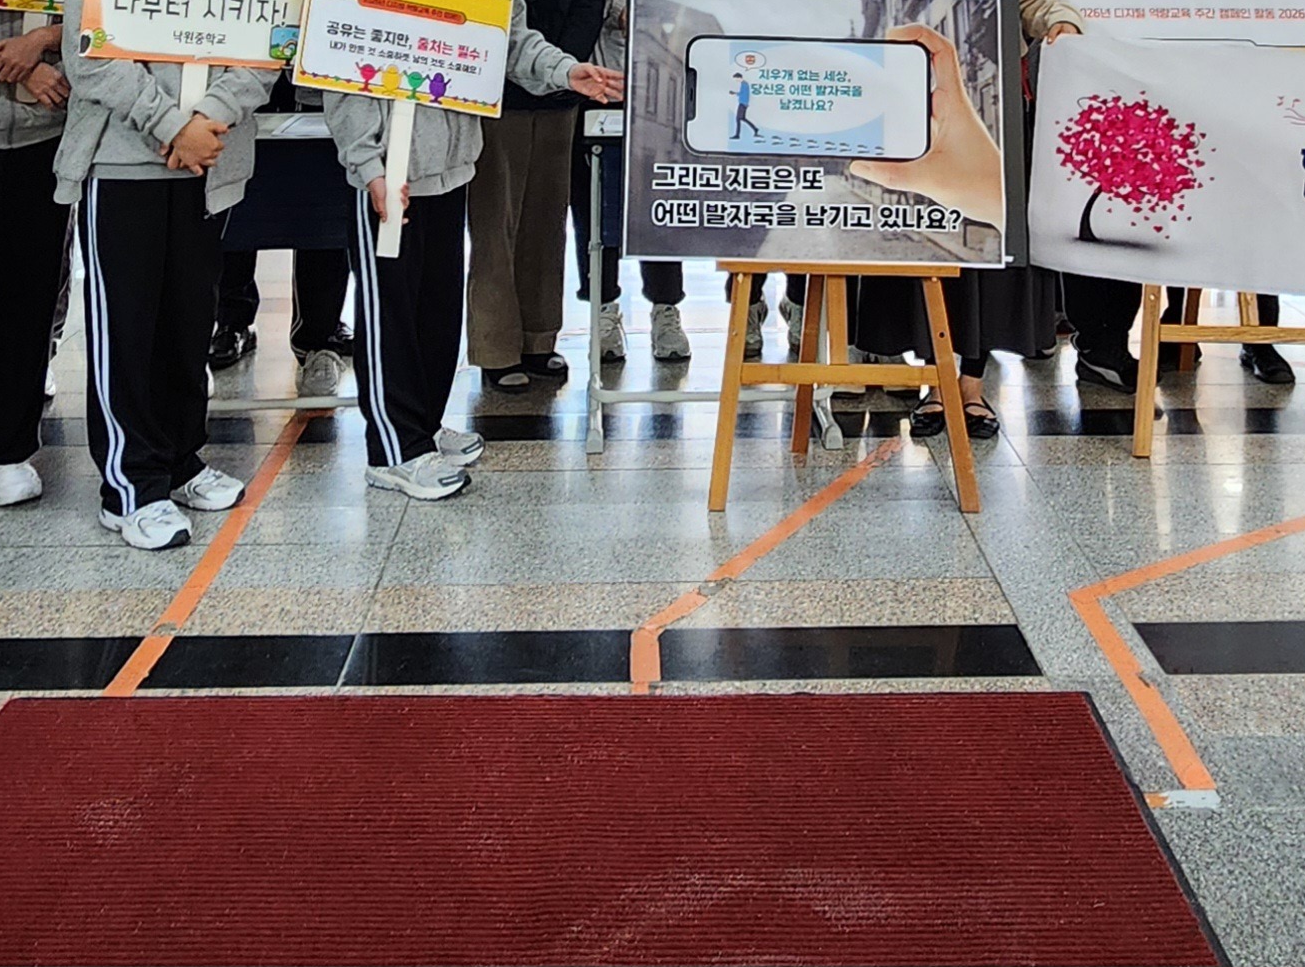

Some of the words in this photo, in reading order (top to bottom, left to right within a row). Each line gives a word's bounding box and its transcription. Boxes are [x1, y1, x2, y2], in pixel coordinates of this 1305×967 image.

[1114, 7, 1146, 19] 디지털
[1148, 7, 1191, 19] 역량교육
[1194, 8, 1216, 20] 주간
[1219, 8, 1252, 20] 캠페인
[172, 30, 227, 46] 낙원중학교
[326, 20, 367, 40] 공유는
[369, 27, 413, 51] 좋지만,
[416, 35, 455, 57] 출처는
[456, 44, 481, 62] 필수
[758, 68, 794, 82] 지우개
[796, 69, 820, 82] 없는
[750, 83, 786, 96] 당신은
[788, 84, 813, 97] 어떤
[815, 85, 864, 98] 발자국을
[779, 98, 835, 112] 남겼나요?
[652, 164, 722, 190] 그리고
[726, 166, 797, 192] 지금은
[801, 167, 824, 191] 또
[652, 200, 700, 228] 어떤
[703, 202, 799, 229] 발자국을
[804, 204, 873, 229] 남기고
[878, 206, 963, 232] 있나요?
